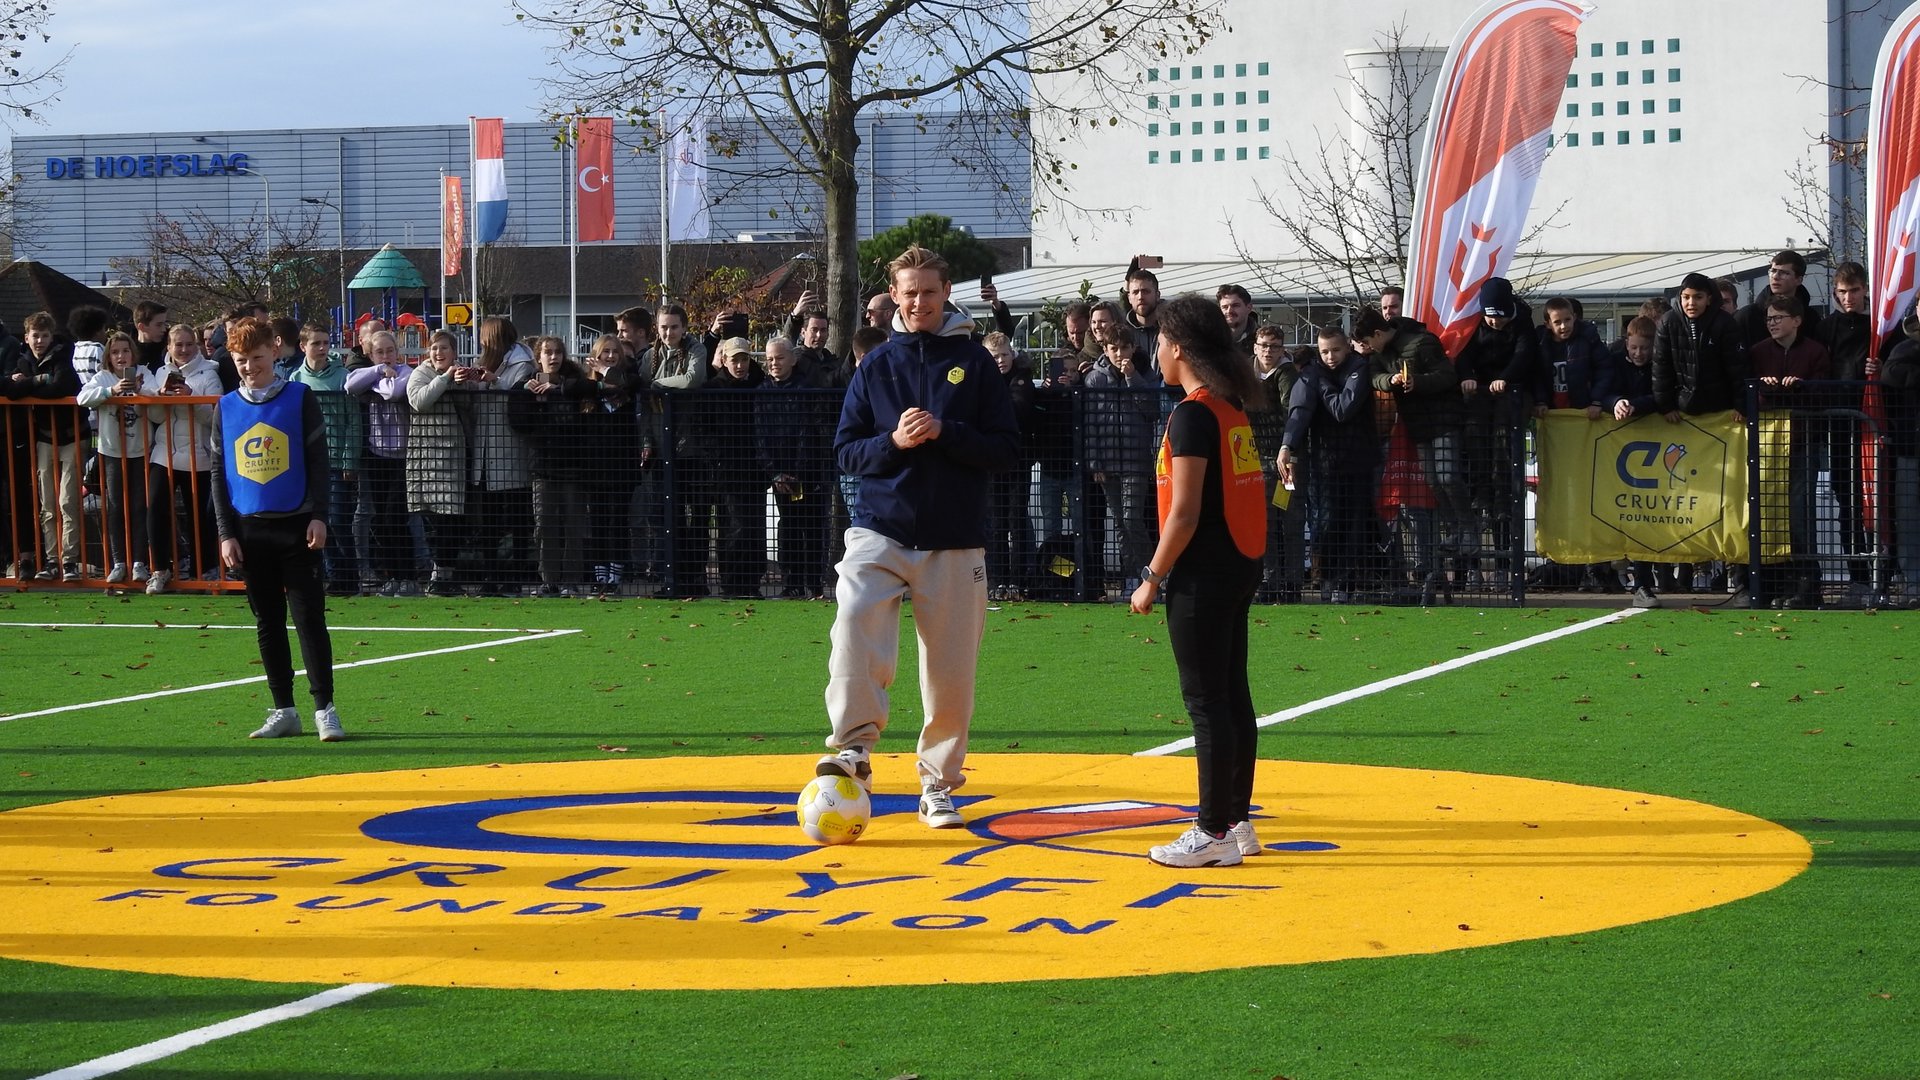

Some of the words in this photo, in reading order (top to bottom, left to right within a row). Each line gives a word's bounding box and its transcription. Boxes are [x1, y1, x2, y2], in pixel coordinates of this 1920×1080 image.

[46, 157, 84, 179] DE
[95, 153, 249, 178] HOEFSLAG
[244, 458, 281, 468] CRUYFF
[1615, 493, 1698, 510] CRUYFF
[1619, 513, 1693, 525] FOUNDATION
[152, 857, 1281, 908] CRUYFF
[96, 888, 1118, 936] FOUNDATION
